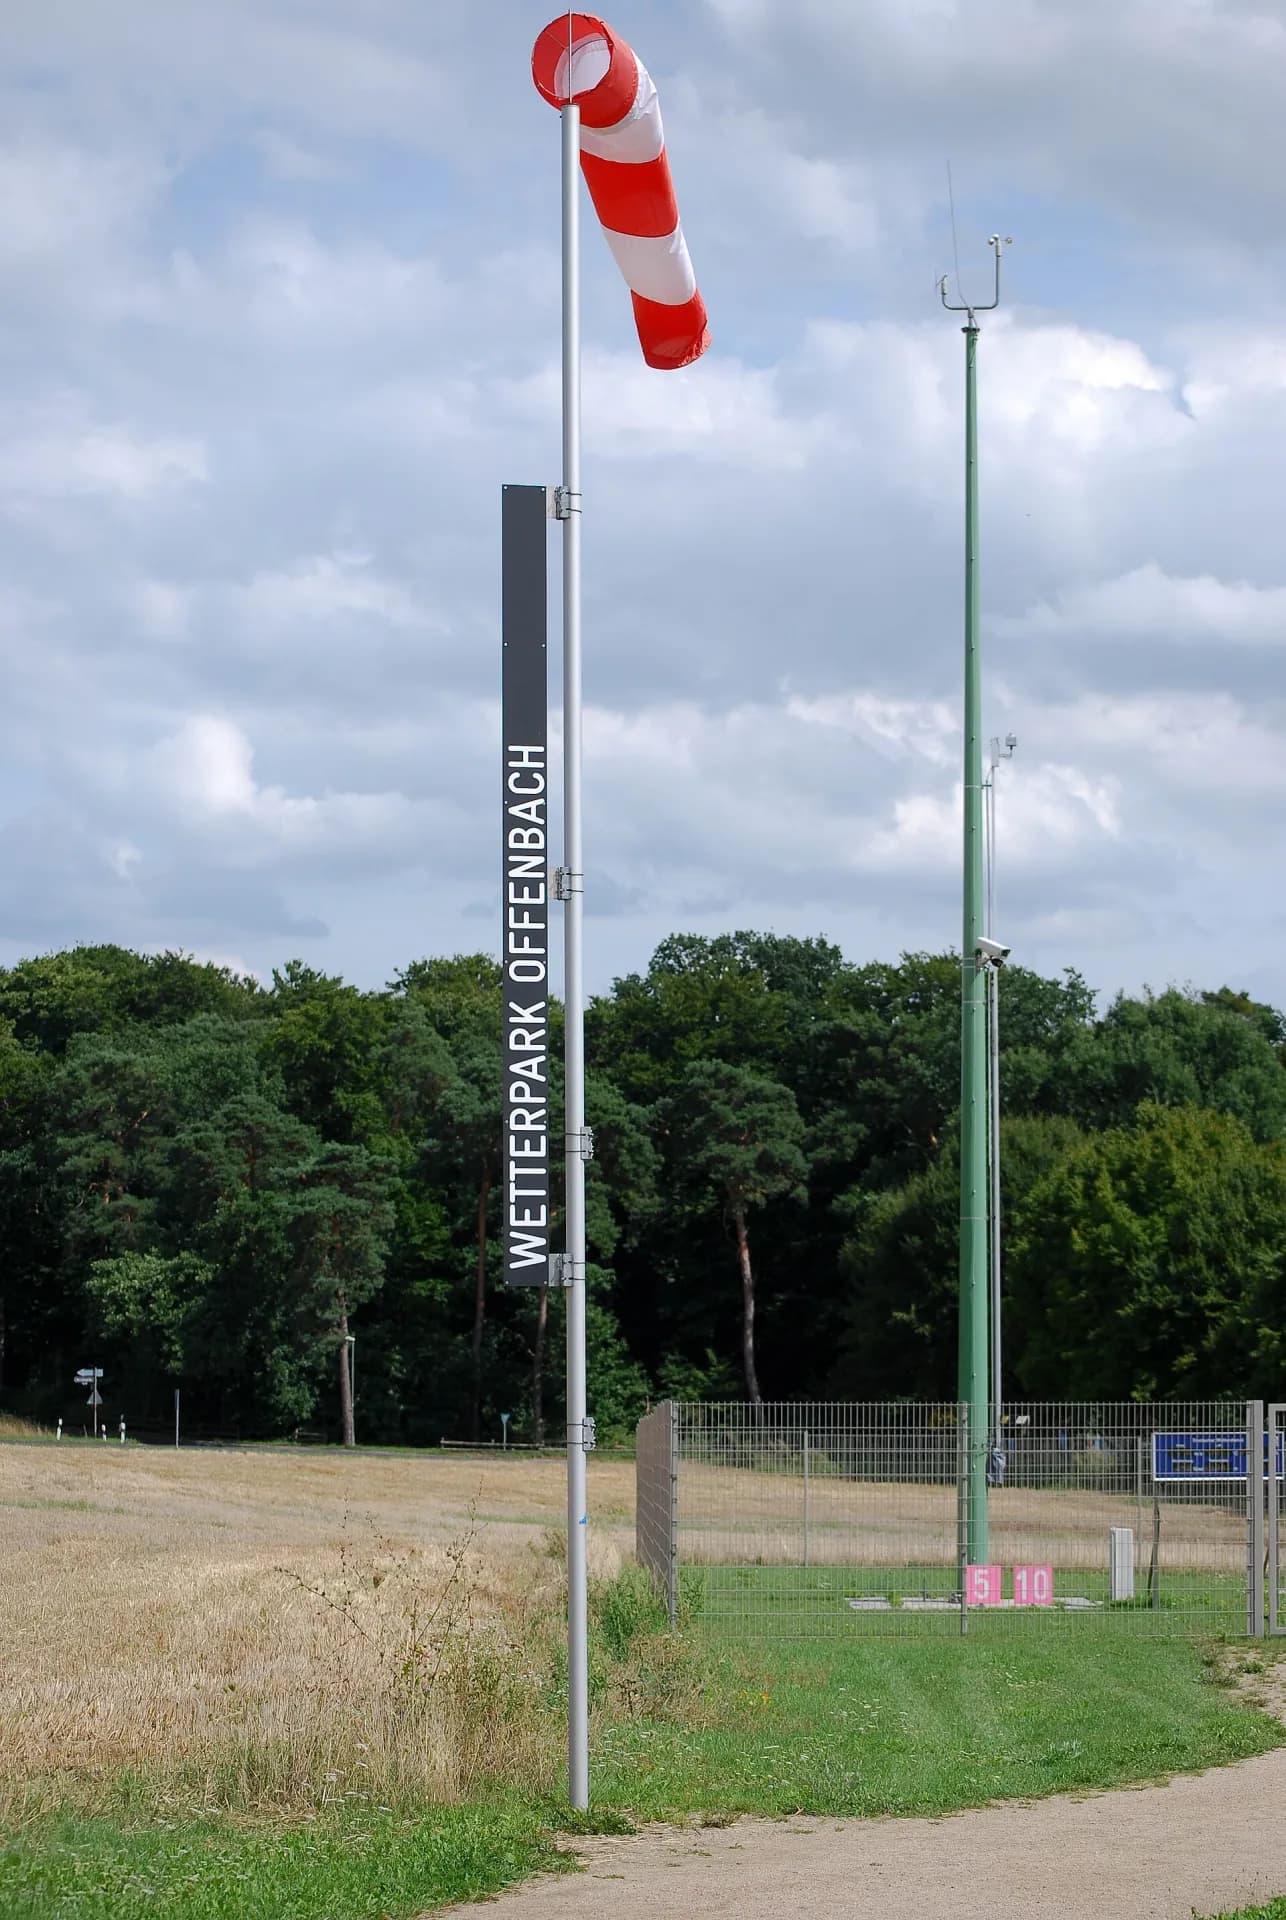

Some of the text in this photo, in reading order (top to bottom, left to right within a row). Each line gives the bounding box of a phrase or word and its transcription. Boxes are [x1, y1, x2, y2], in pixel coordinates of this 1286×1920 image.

[508, 744, 547, 1269] WETTERPARK OFFENBACH
[974, 1569, 990, 1600] 5
[1016, 1569, 1049, 1600] 10
